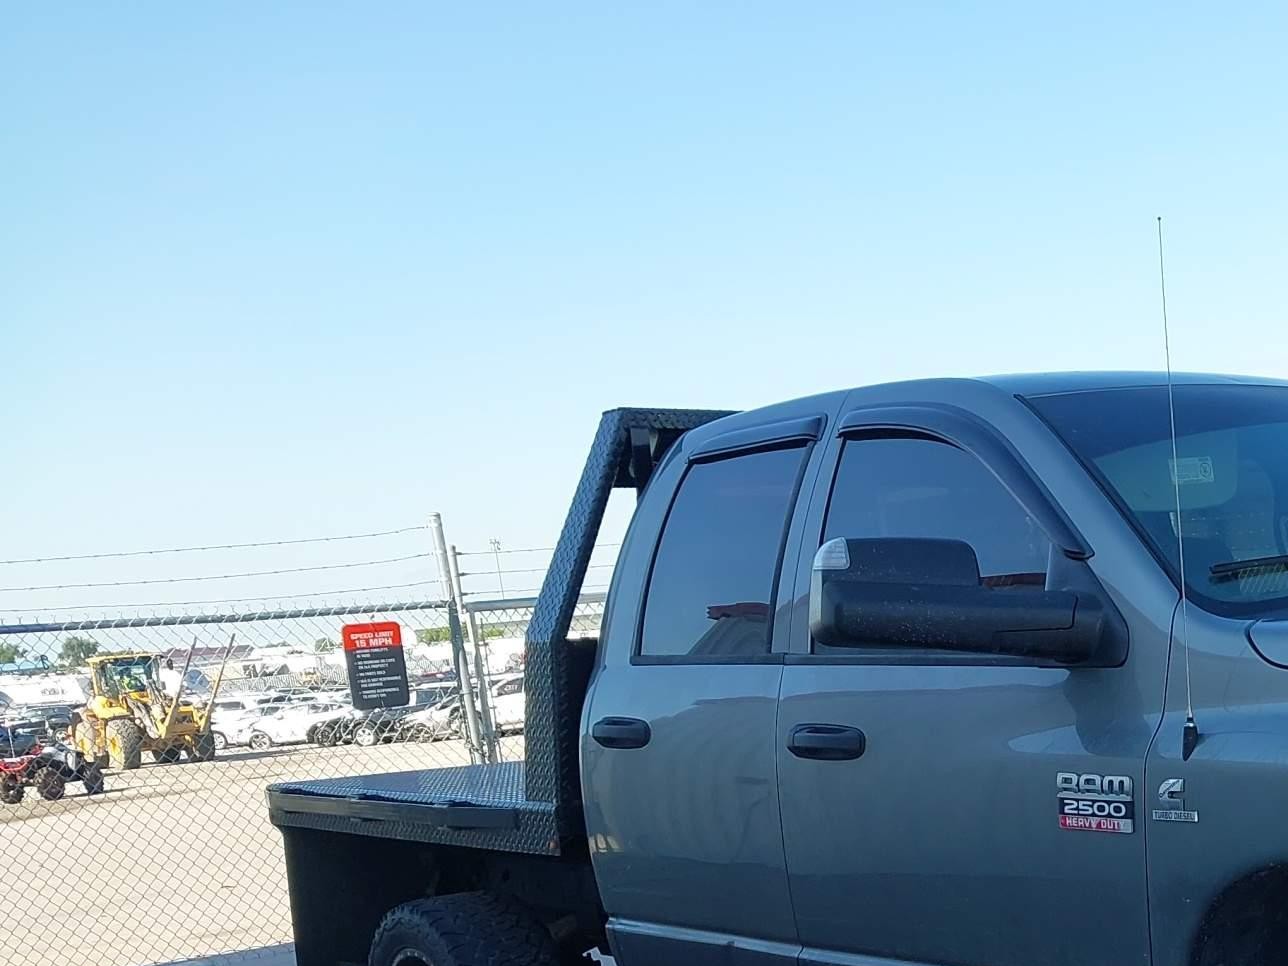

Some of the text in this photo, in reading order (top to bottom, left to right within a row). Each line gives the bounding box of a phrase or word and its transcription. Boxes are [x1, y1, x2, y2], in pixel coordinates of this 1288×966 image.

[350, 630, 394, 640] SPEED LIMIT
[355, 637, 393, 648] 15 MPH
[1056, 772, 1133, 797] RAM
[1063, 800, 1126, 817] 2500
[1066, 817, 1126, 830] HEAVY DUTY
